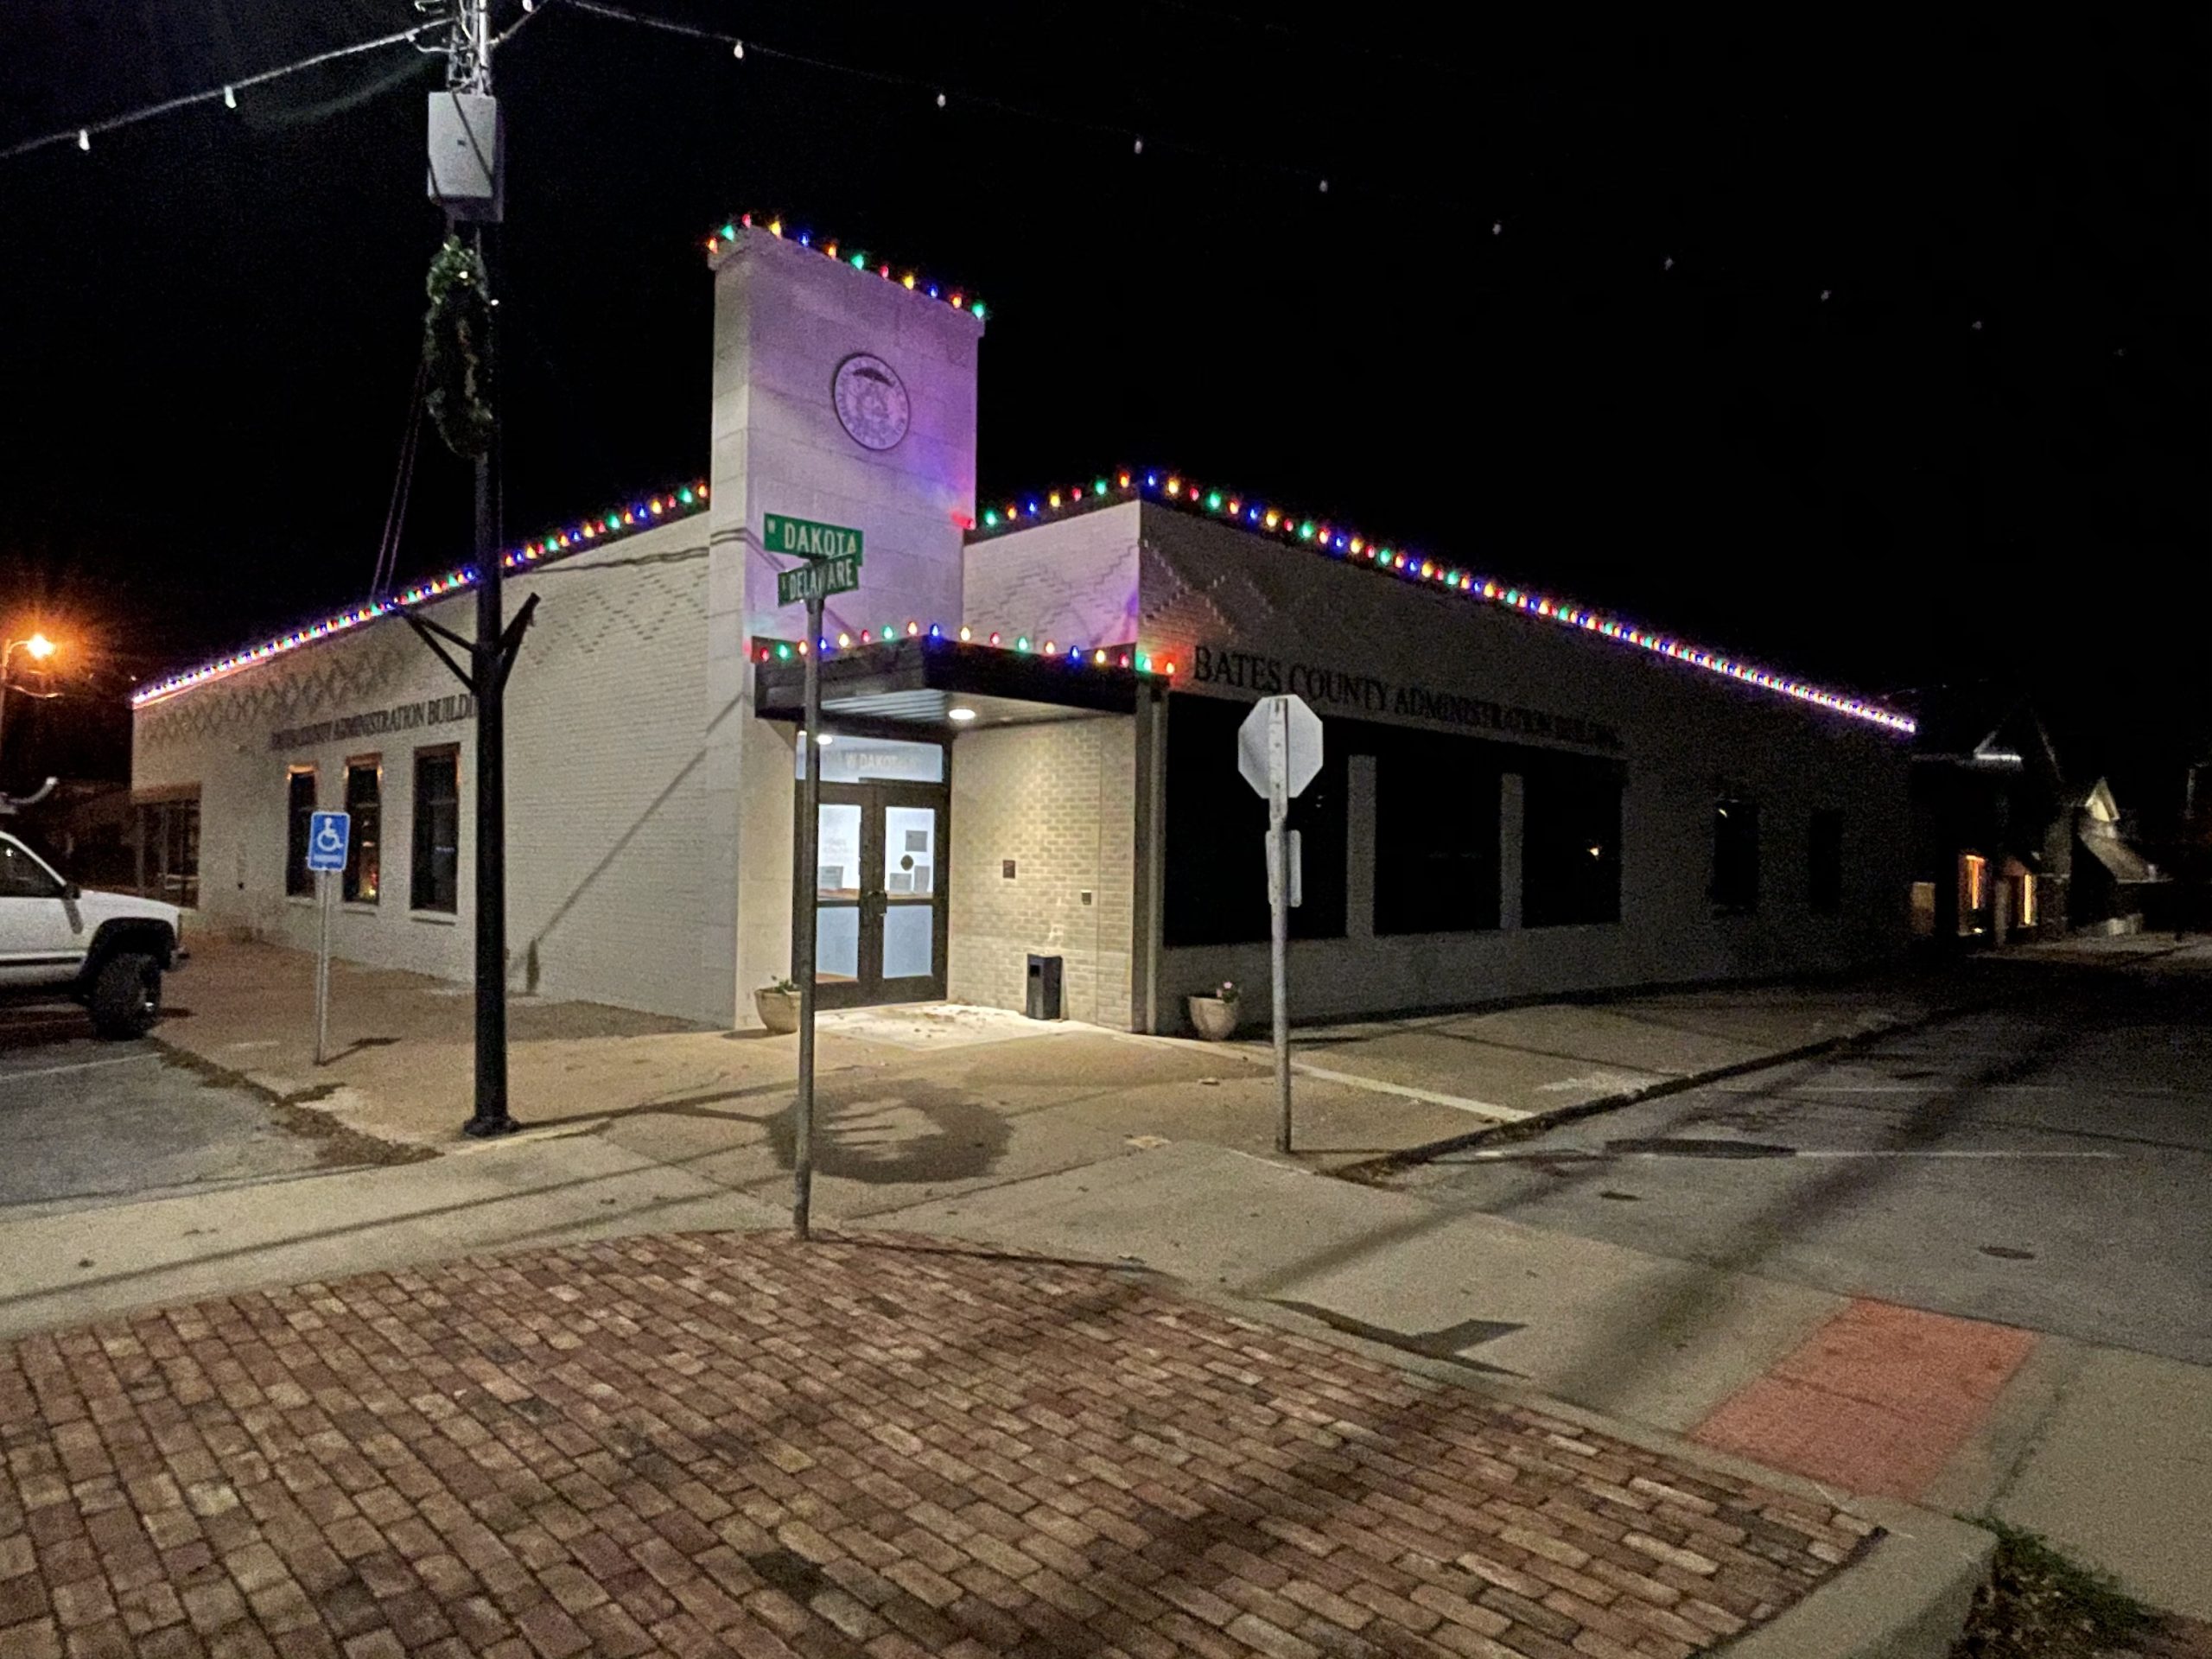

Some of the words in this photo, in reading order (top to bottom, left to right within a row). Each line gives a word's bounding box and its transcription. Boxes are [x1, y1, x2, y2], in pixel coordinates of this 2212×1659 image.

[767, 520, 776, 534] W
[785, 522, 856, 556] DAKOTA
[790, 559, 854, 600] DELAWARE
[1194, 645, 1282, 693] BATES
[1288, 664, 1389, 711] COUNTY
[859, 753, 906, 770] DAKOT
